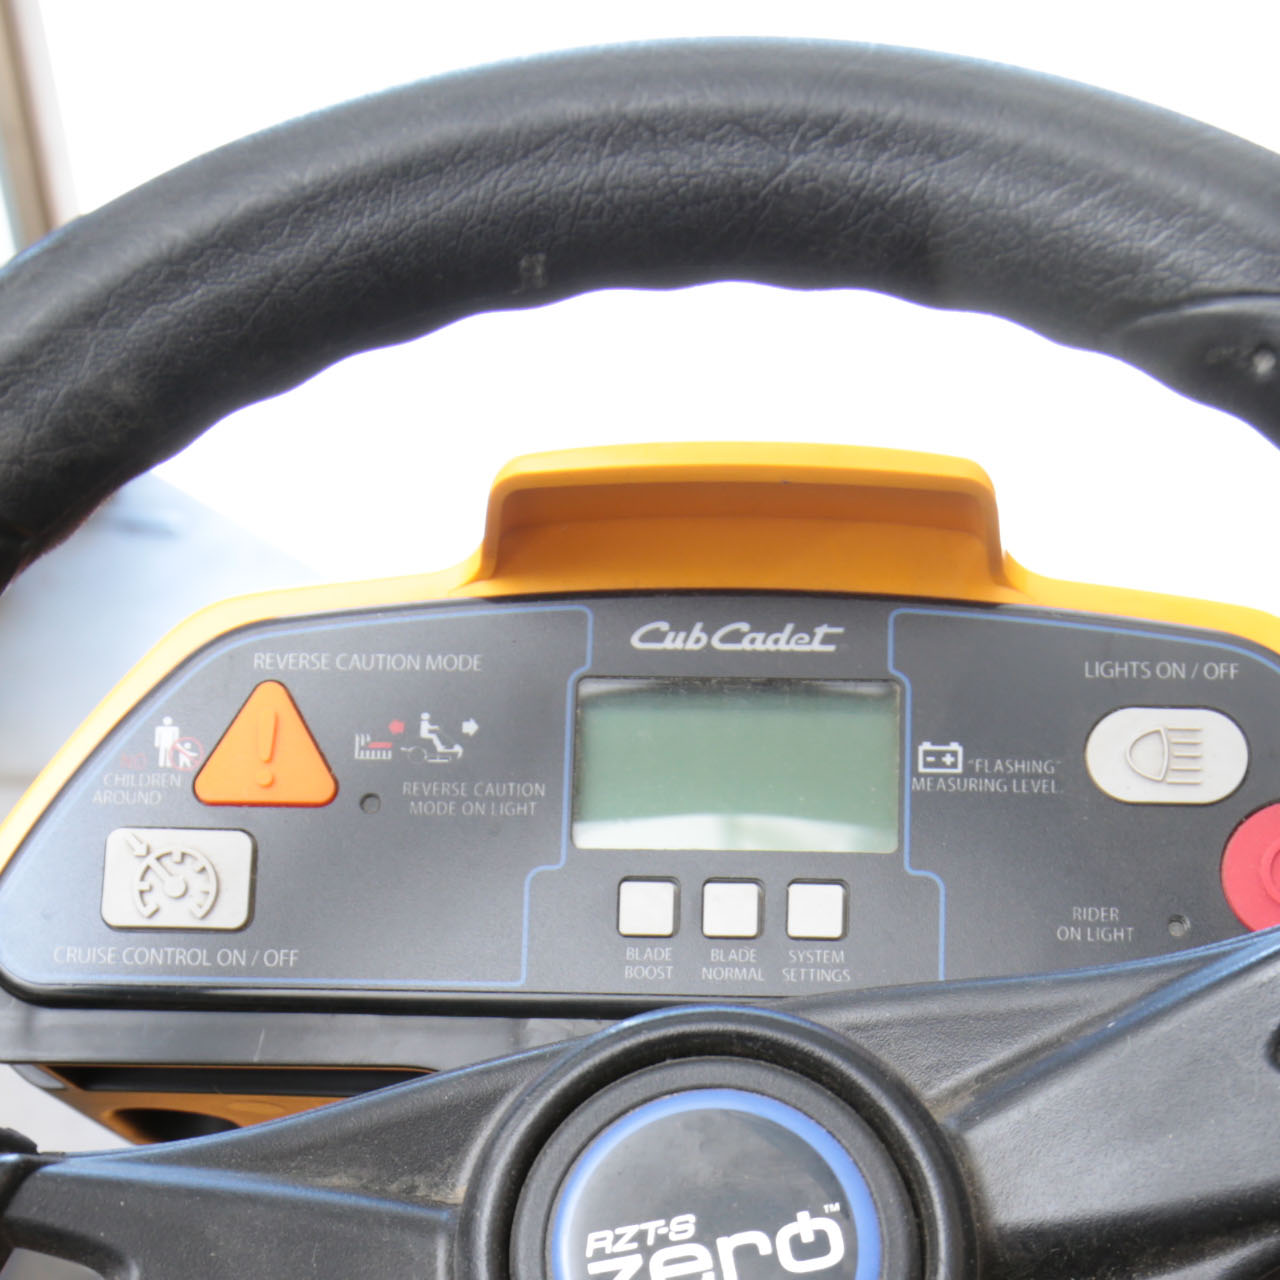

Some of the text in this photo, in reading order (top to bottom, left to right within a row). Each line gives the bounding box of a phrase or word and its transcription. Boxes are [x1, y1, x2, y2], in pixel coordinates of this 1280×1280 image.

[630, 621, 845, 652] Cub Cadet
[253, 652, 483, 672] REVERSE CAUTION MODE
[1084, 661, 1240, 680] LIGHTS ON / OFF
[103, 772, 182, 788] CHILDREN
[911, 776, 1008, 793] MEASURING
[93, 789, 163, 806] AROUND
[402, 781, 546, 798] REVERSE CAUTION
[409, 800, 537, 817] MODE ON LIGHT
[1072, 906, 1119, 922] RIDER
[1056, 926, 1134, 942] ON LIGHT
[53, 946, 117, 965] CRUISE
[122, 947, 211, 967] CONTROL
[216, 948, 246, 967] ON
[263, 949, 299, 967] OFF
[625, 946, 672, 962] BLADE
[710, 948, 757, 963] BLADE
[788, 950, 845, 964] SYSTEM
[624, 965, 674, 980] BOOST
[701, 966, 765, 982] NORMAL
[782, 967, 851, 982] SETTINGS
[585, 1213, 697, 1258] RZT-S
